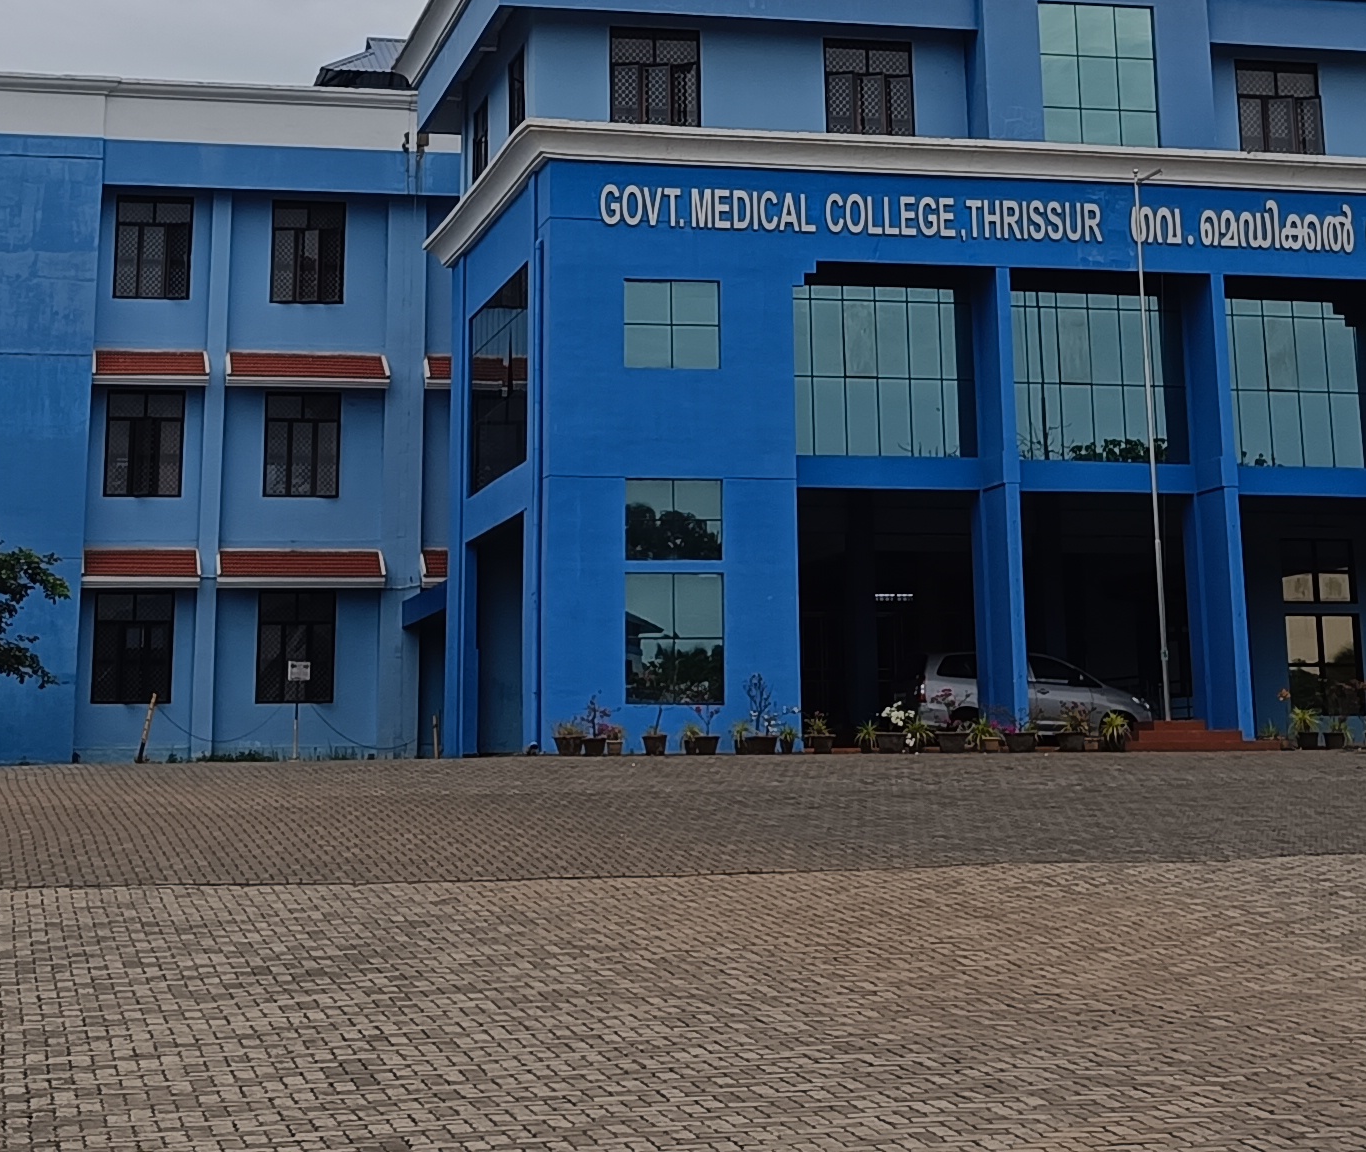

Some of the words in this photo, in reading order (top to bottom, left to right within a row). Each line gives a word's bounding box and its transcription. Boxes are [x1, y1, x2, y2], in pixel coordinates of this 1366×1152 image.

[599, 184, 685, 227] GOVT.
[691, 188, 817, 233] MEDICAL
[965, 199, 1103, 242] THRISSUR
[1200, 199, 1355, 253] മെഡിക്കൽ
